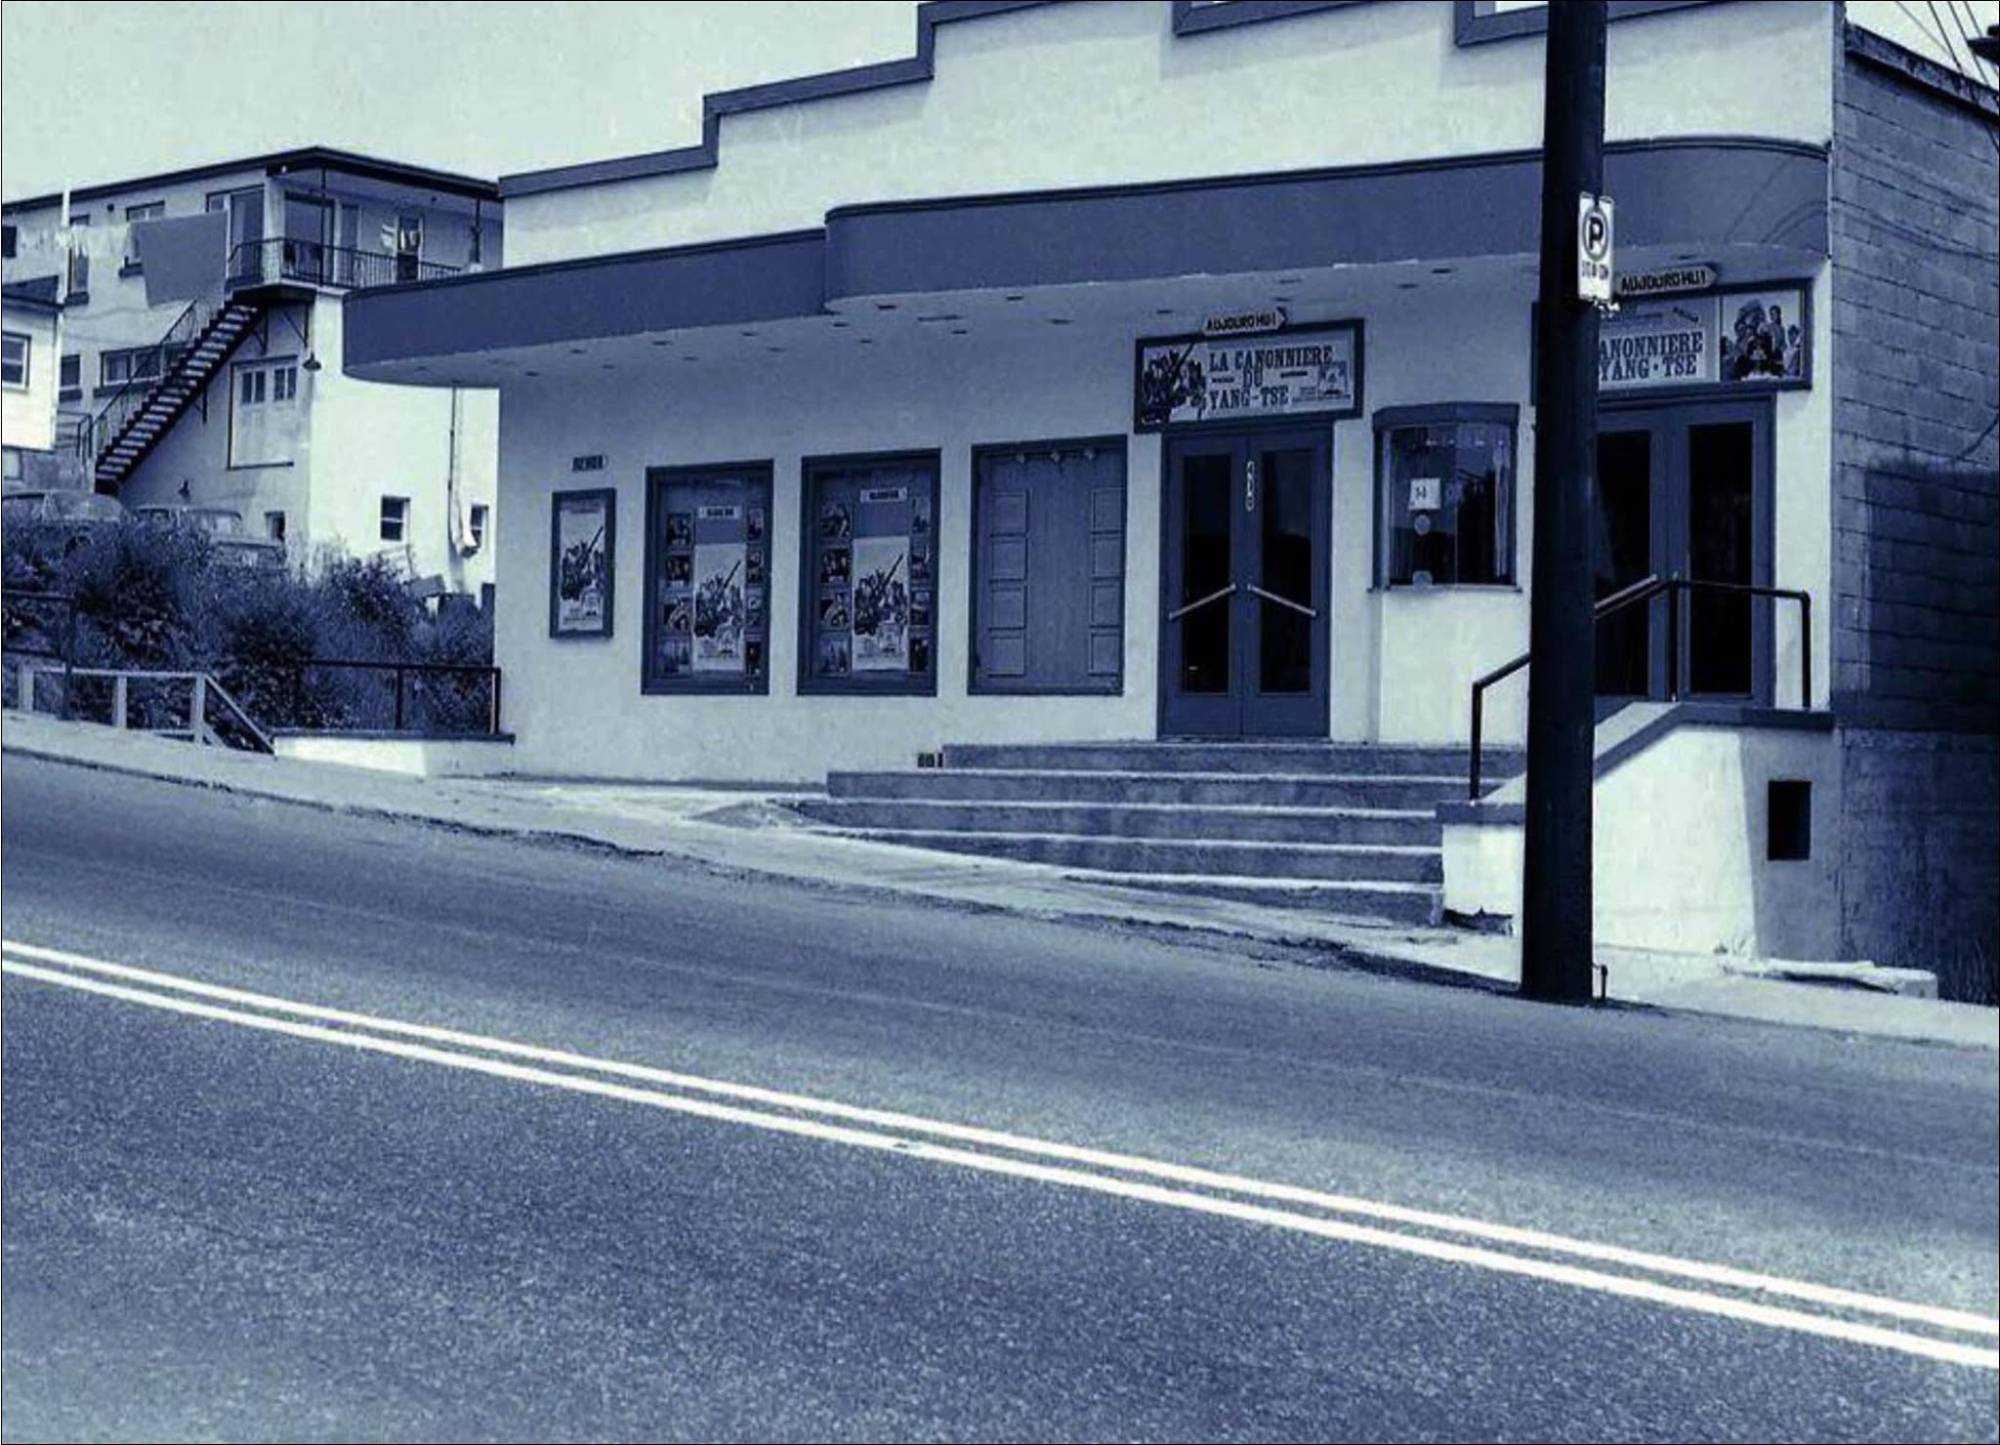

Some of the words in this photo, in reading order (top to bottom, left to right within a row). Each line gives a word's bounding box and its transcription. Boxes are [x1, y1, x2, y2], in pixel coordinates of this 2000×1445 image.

[1589, 216, 1604, 251] P
[1600, 332, 1704, 359] ANONNIERE
[1209, 351, 1229, 371] LA
[1235, 347, 1333, 370] CANONNIERE
[1243, 368, 1263, 388] DU
